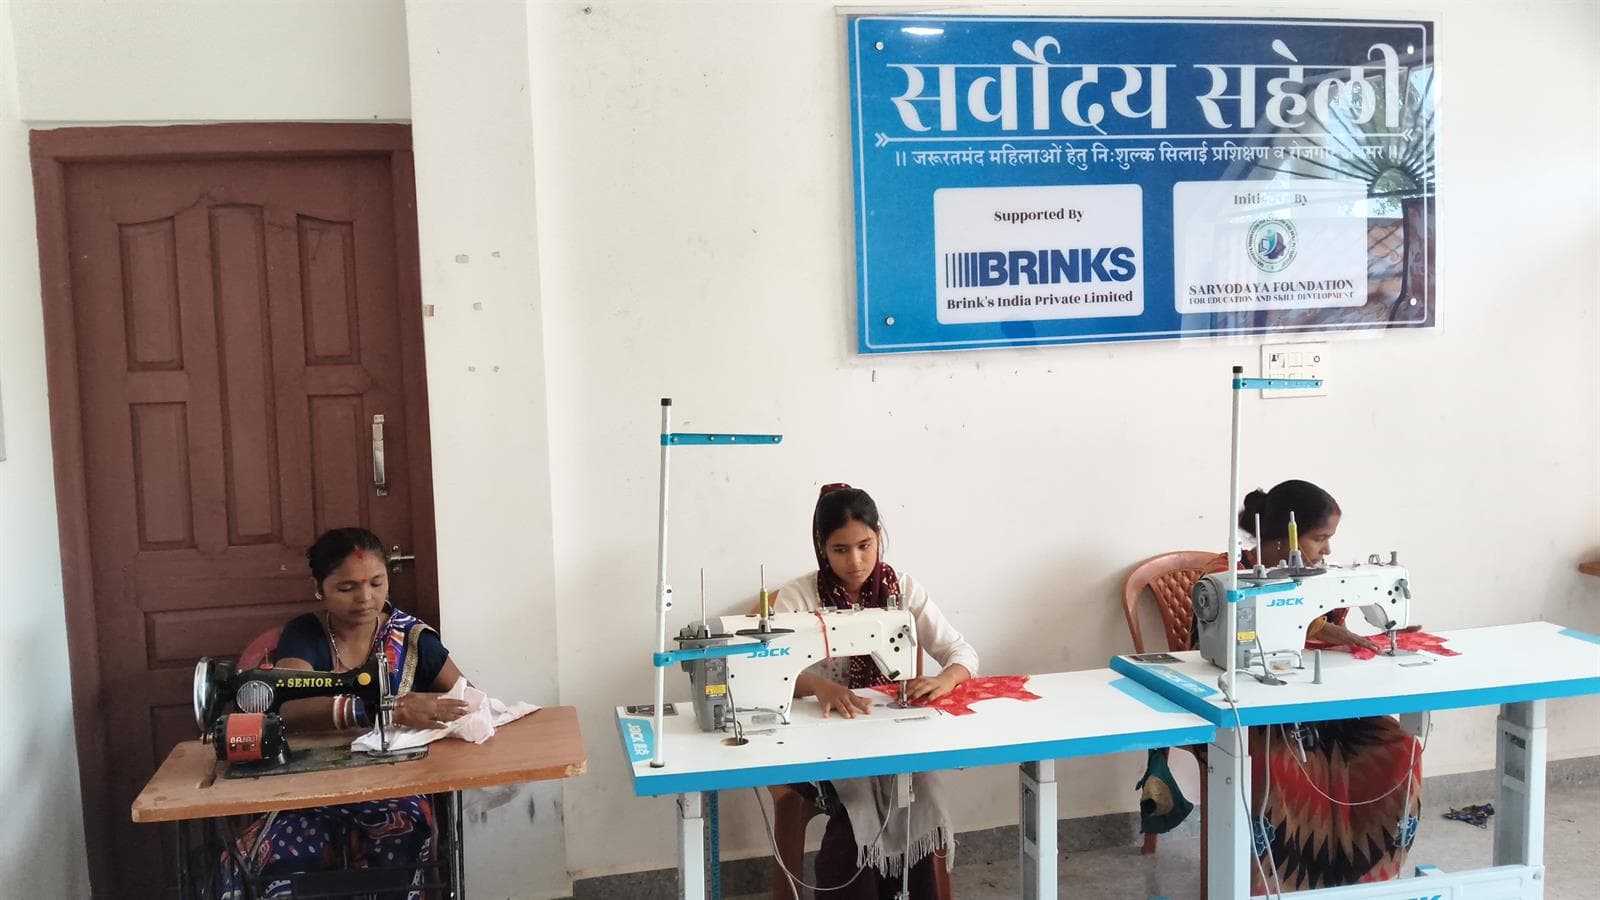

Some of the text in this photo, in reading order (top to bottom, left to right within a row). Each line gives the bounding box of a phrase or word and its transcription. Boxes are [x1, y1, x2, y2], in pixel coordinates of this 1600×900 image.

[886, 36, 1404, 135] सर्वोदय सहेली
[912, 147, 985, 166] जरूरतमंद
[989, 143, 1062, 165] महिलाओं
[1066, 143, 1088, 170] हेतु
[1159, 142, 1208, 164] सिलाई
[1212, 142, 1269, 161] प्रशिक्षण
[1273, 147, 1286, 159] व
[1234, 192, 1308, 206] Initi By
[994, 208, 1084, 224] Supported By
[978, 246, 1137, 287] BRINKS
[1189, 279, 1354, 296] SARVODAYA FOUNDATION
[947, 291, 1134, 310] Brink's India Private Limited
[1207, 295, 1253, 304] EDUCATION
[1255, 294, 1272, 302] AND
[287, 678, 333, 688] SENIOR
